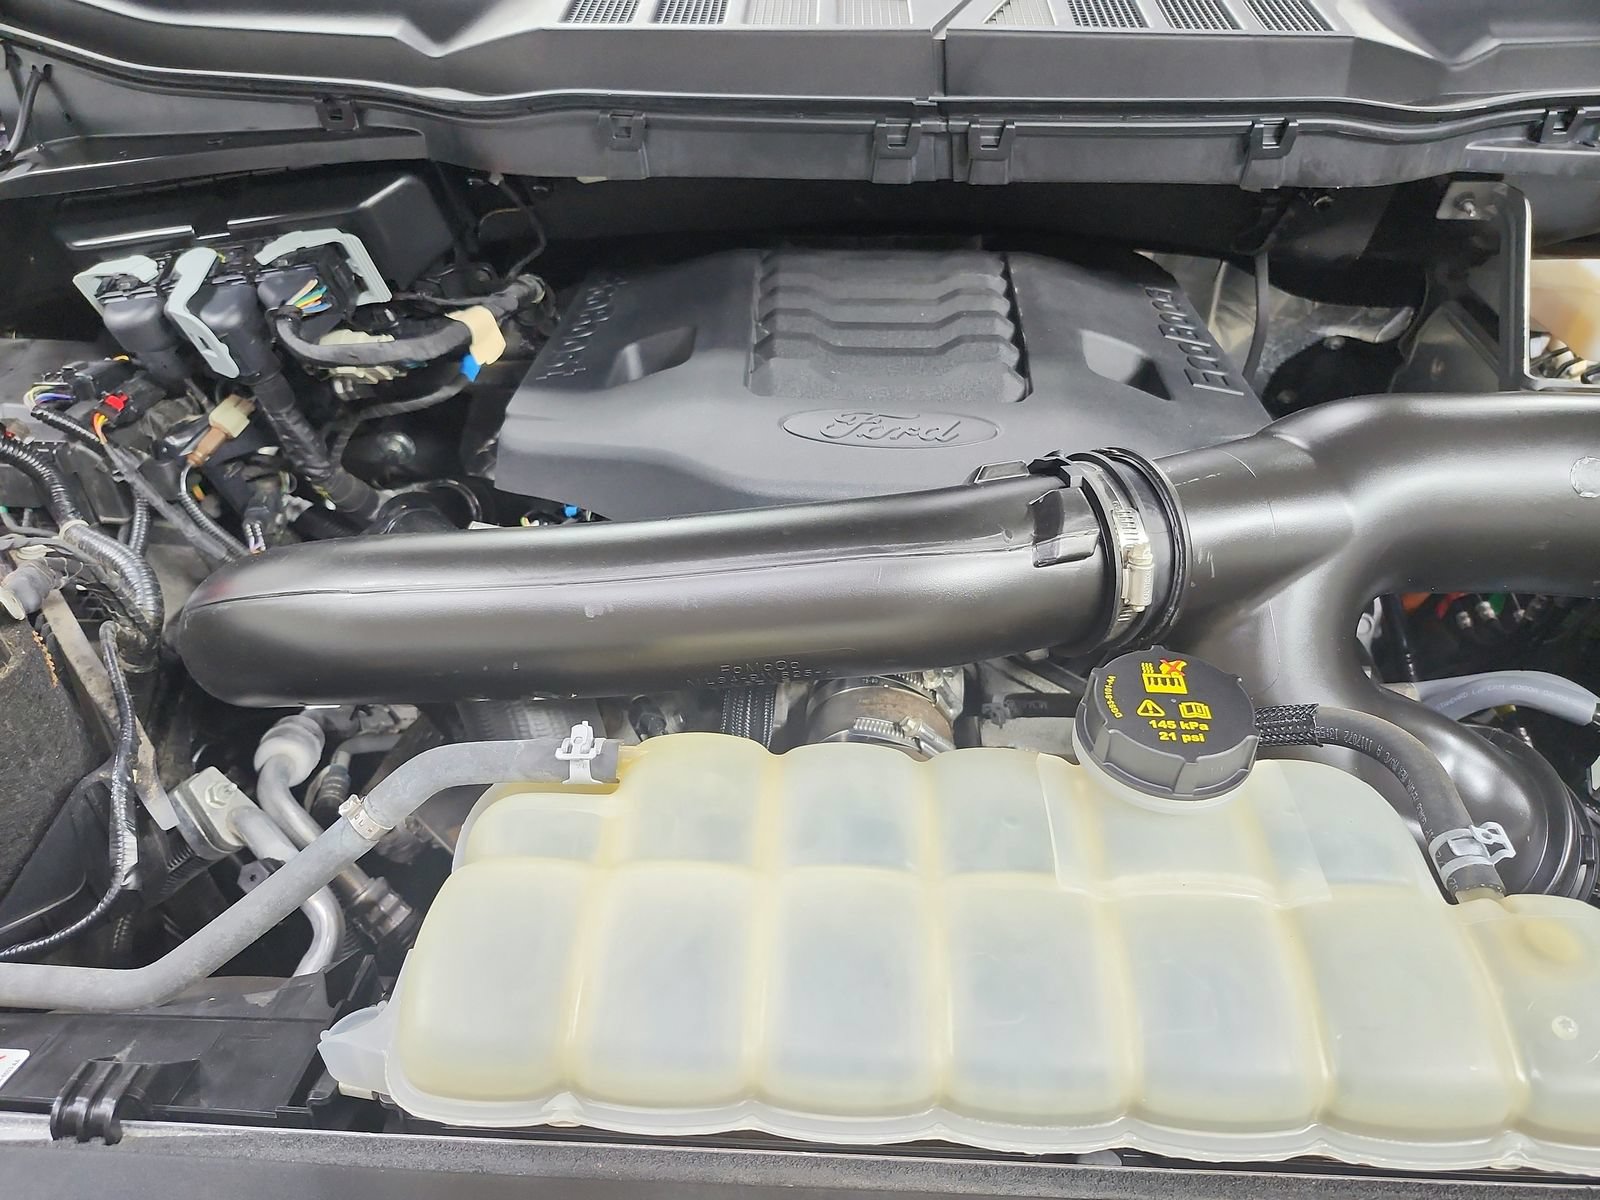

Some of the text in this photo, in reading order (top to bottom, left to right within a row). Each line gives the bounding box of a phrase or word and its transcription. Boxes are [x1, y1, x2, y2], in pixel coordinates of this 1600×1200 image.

[819, 411, 961, 443] Ford
[1149, 719, 1210, 731] 145 kPa
[1158, 731, 1206, 744] 21 psi
